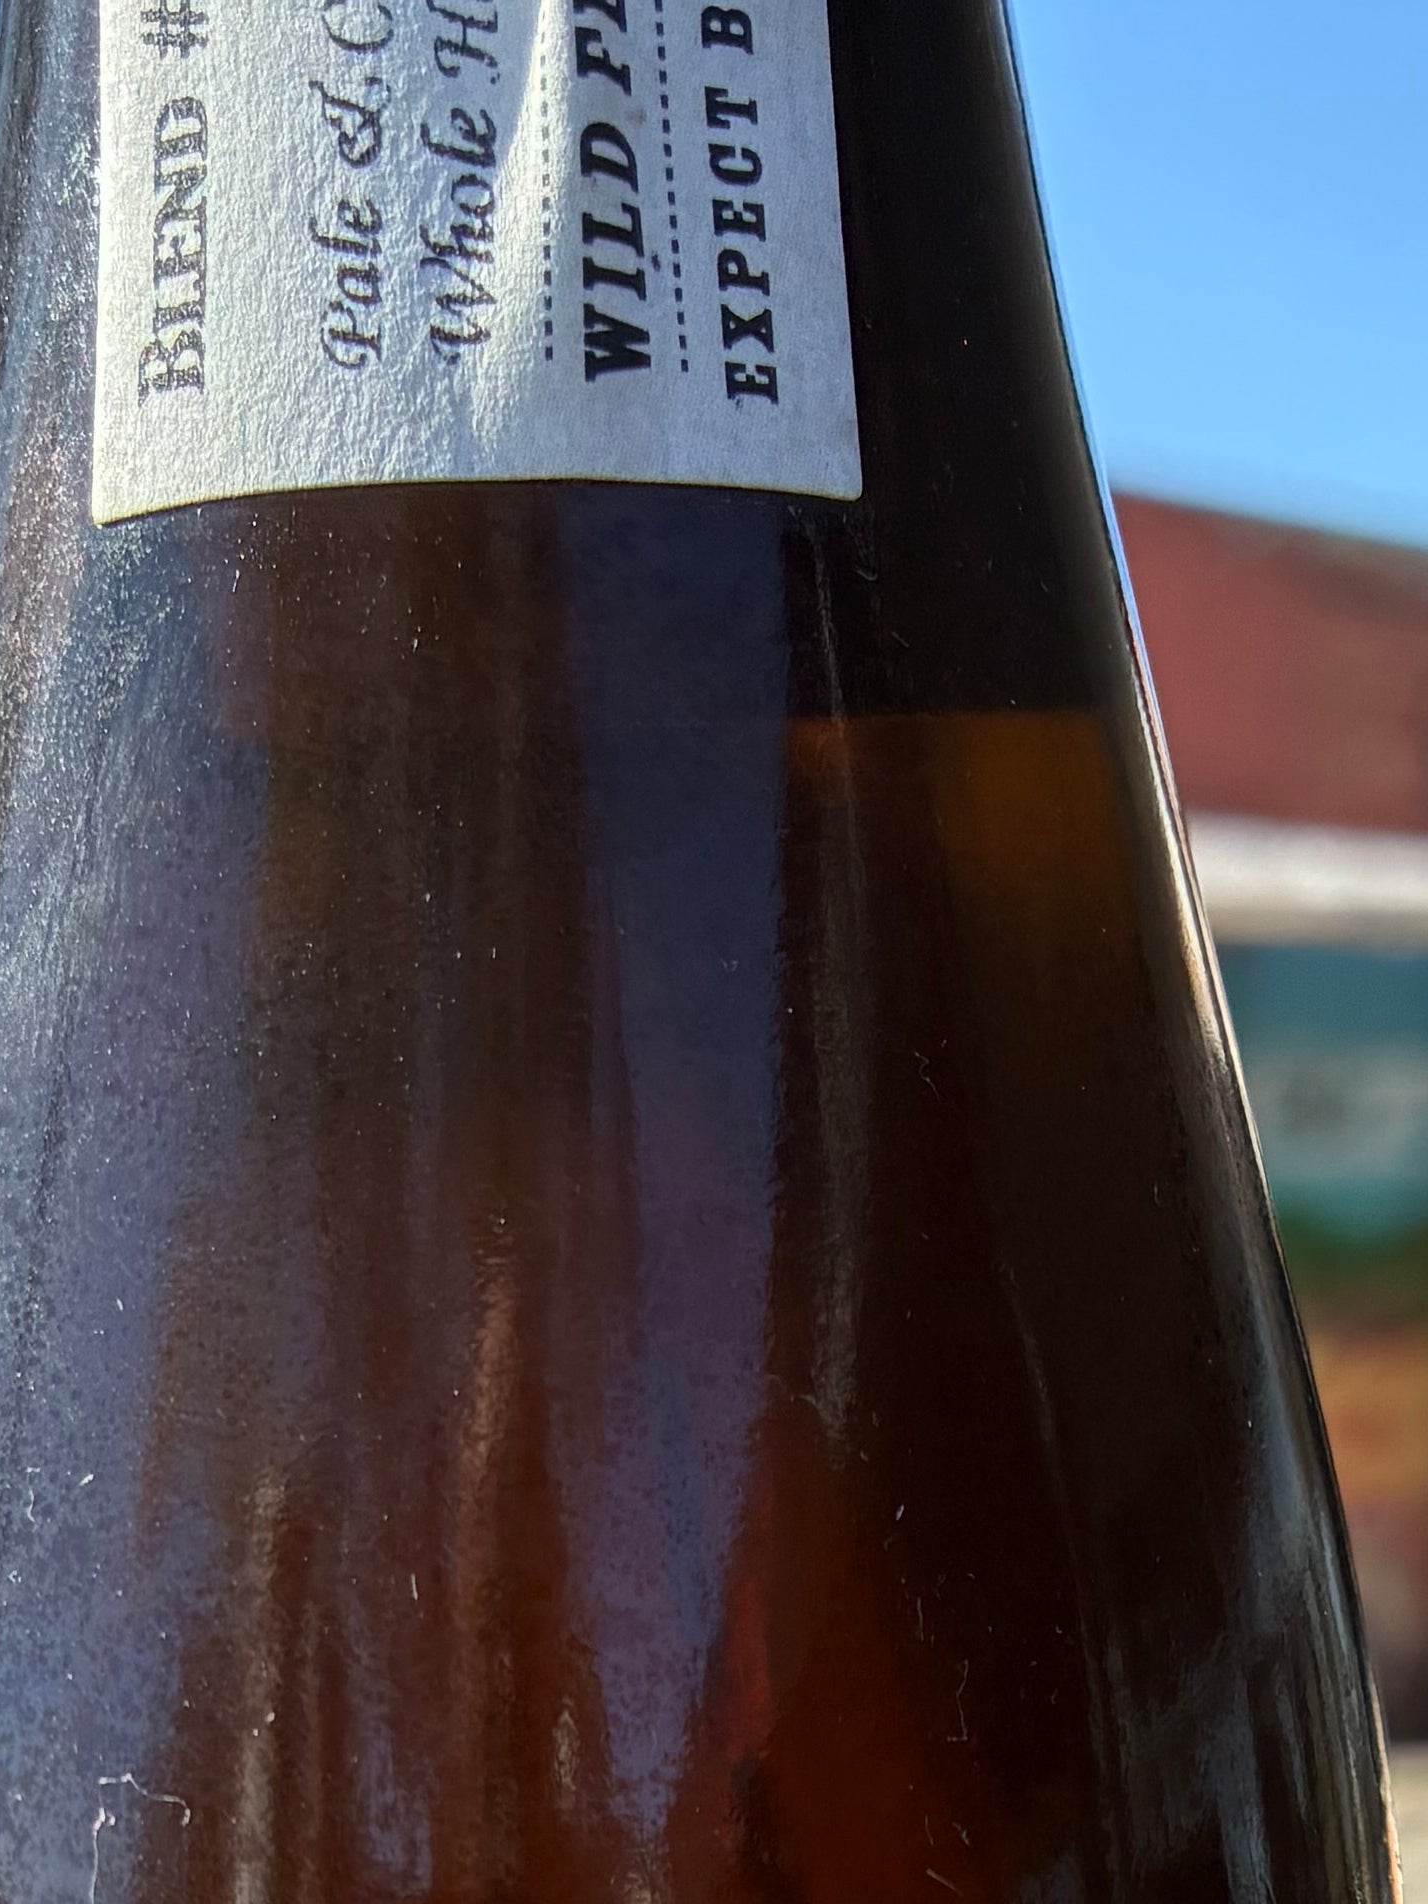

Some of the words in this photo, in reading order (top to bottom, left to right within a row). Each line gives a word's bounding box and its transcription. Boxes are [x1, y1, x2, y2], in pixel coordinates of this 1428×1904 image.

[310, 194, 384, 370] Pale
[421, 106, 496, 366] Whole
[580, 121, 653, 383] WILD
[703, 86, 779, 406] EXPECT
